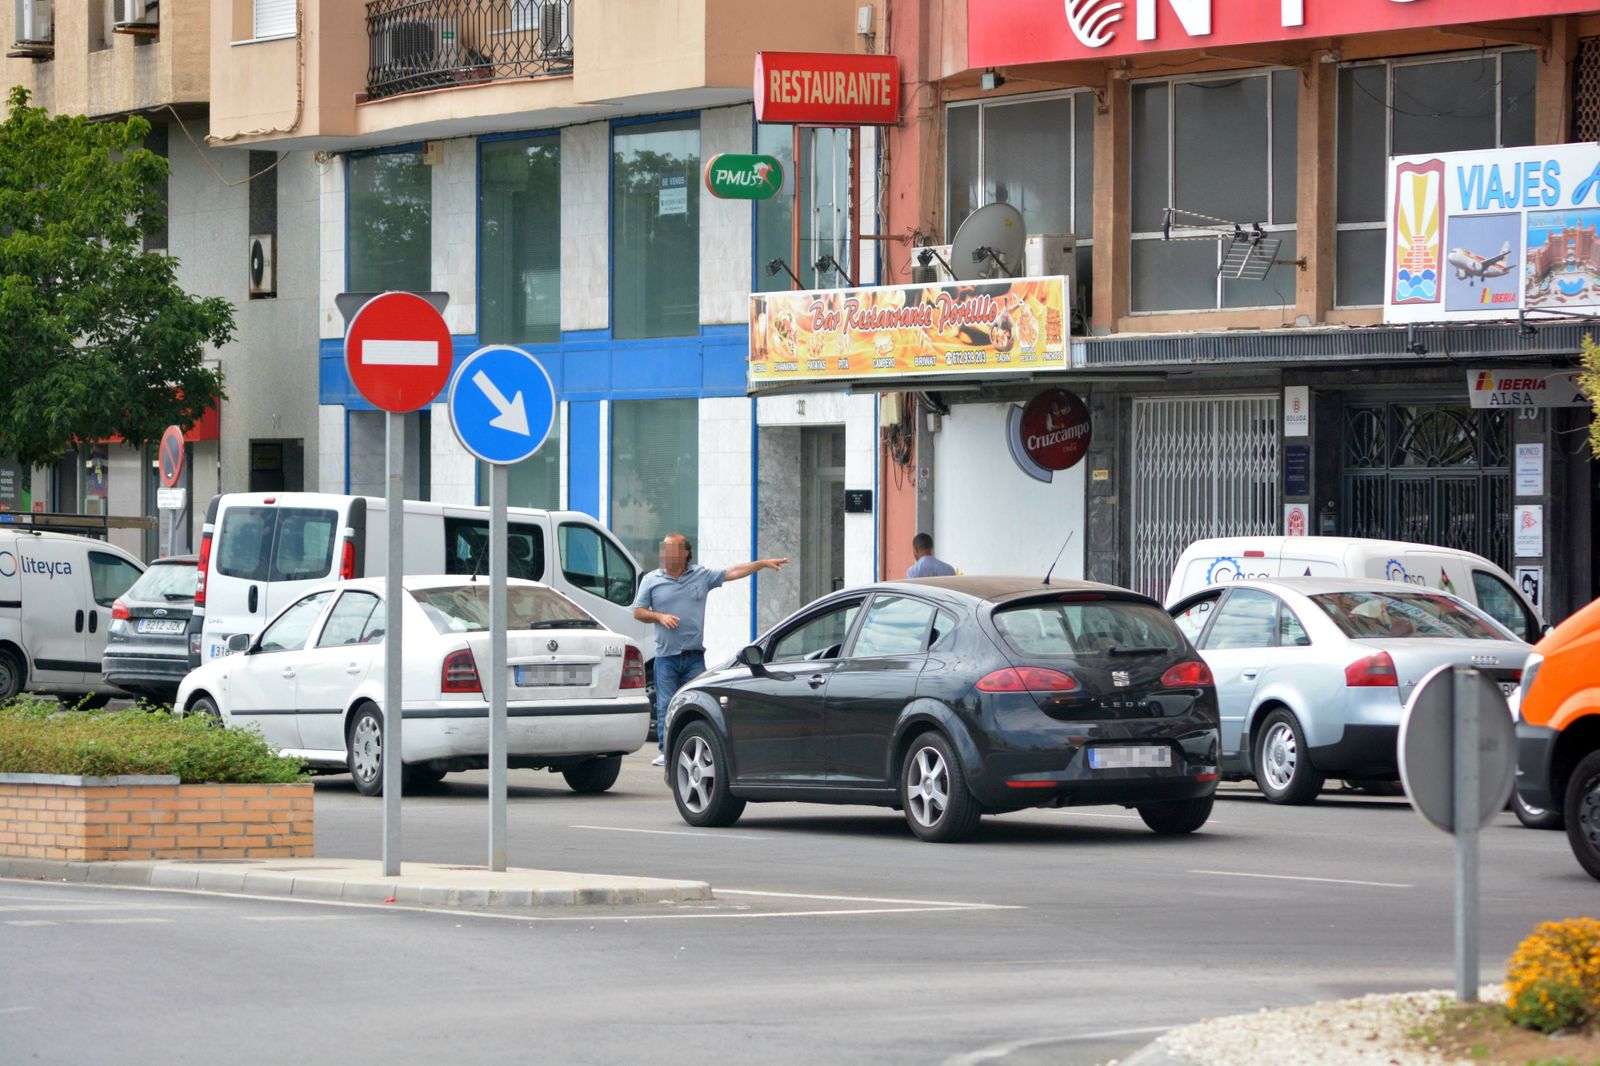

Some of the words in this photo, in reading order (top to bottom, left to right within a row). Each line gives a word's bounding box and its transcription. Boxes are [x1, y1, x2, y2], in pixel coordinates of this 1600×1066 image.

[770, 69, 891, 106] RESTAURANTE
[715, 169, 752, 186] PMU
[1457, 160, 1561, 210] VIAJES
[1491, 293, 1516, 303] IBERIA
[809, 300, 841, 332] Bar
[843, 298, 932, 336] Restaurante
[935, 291, 998, 336] Portillo
[807, 359, 826, 370] PATATAS
[838, 357, 849, 369] PITA
[1497, 379, 1547, 390] IBERIA
[1489, 392, 1534, 405] ALSA
[1027, 422, 1090, 450] Cruzcampo
[21, 554, 72, 580] liteyca
[145, 619, 165, 631] 8212
